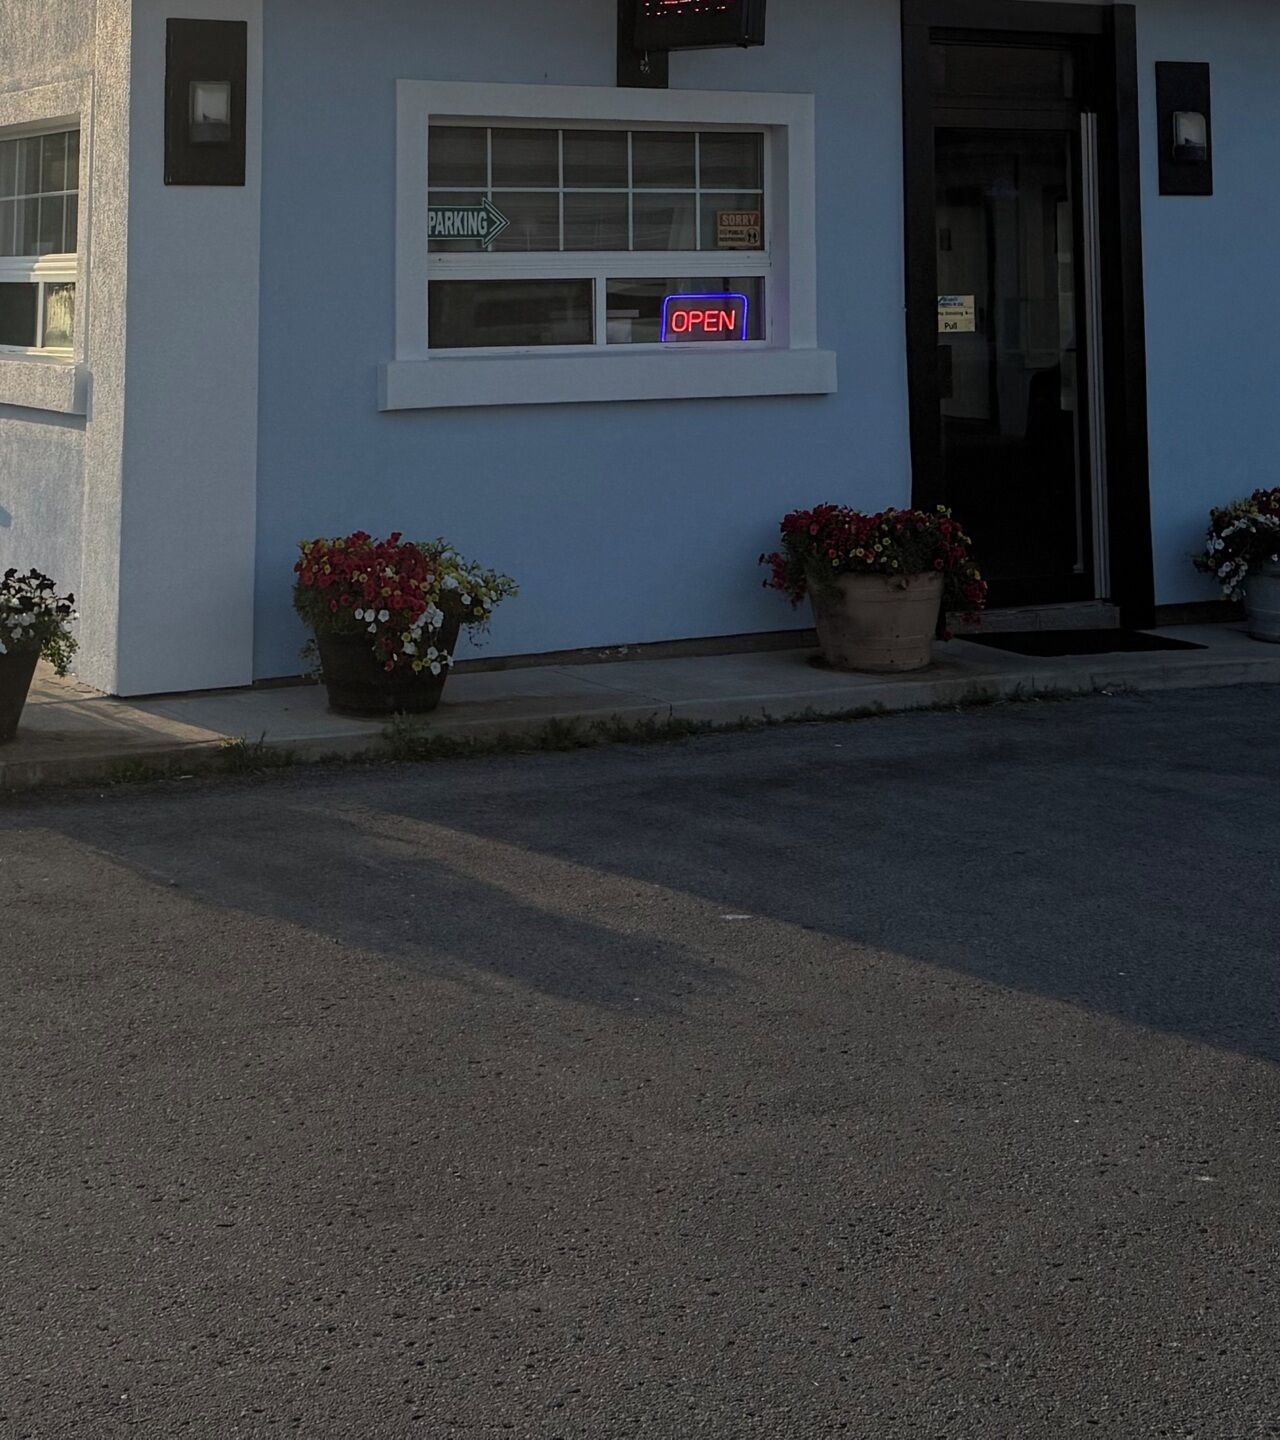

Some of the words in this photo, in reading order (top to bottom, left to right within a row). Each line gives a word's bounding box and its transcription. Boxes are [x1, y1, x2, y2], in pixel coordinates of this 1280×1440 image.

[428, 211, 488, 235] PARKING
[722, 214, 756, 226] SORRY
[671, 309, 736, 332] OPEN
